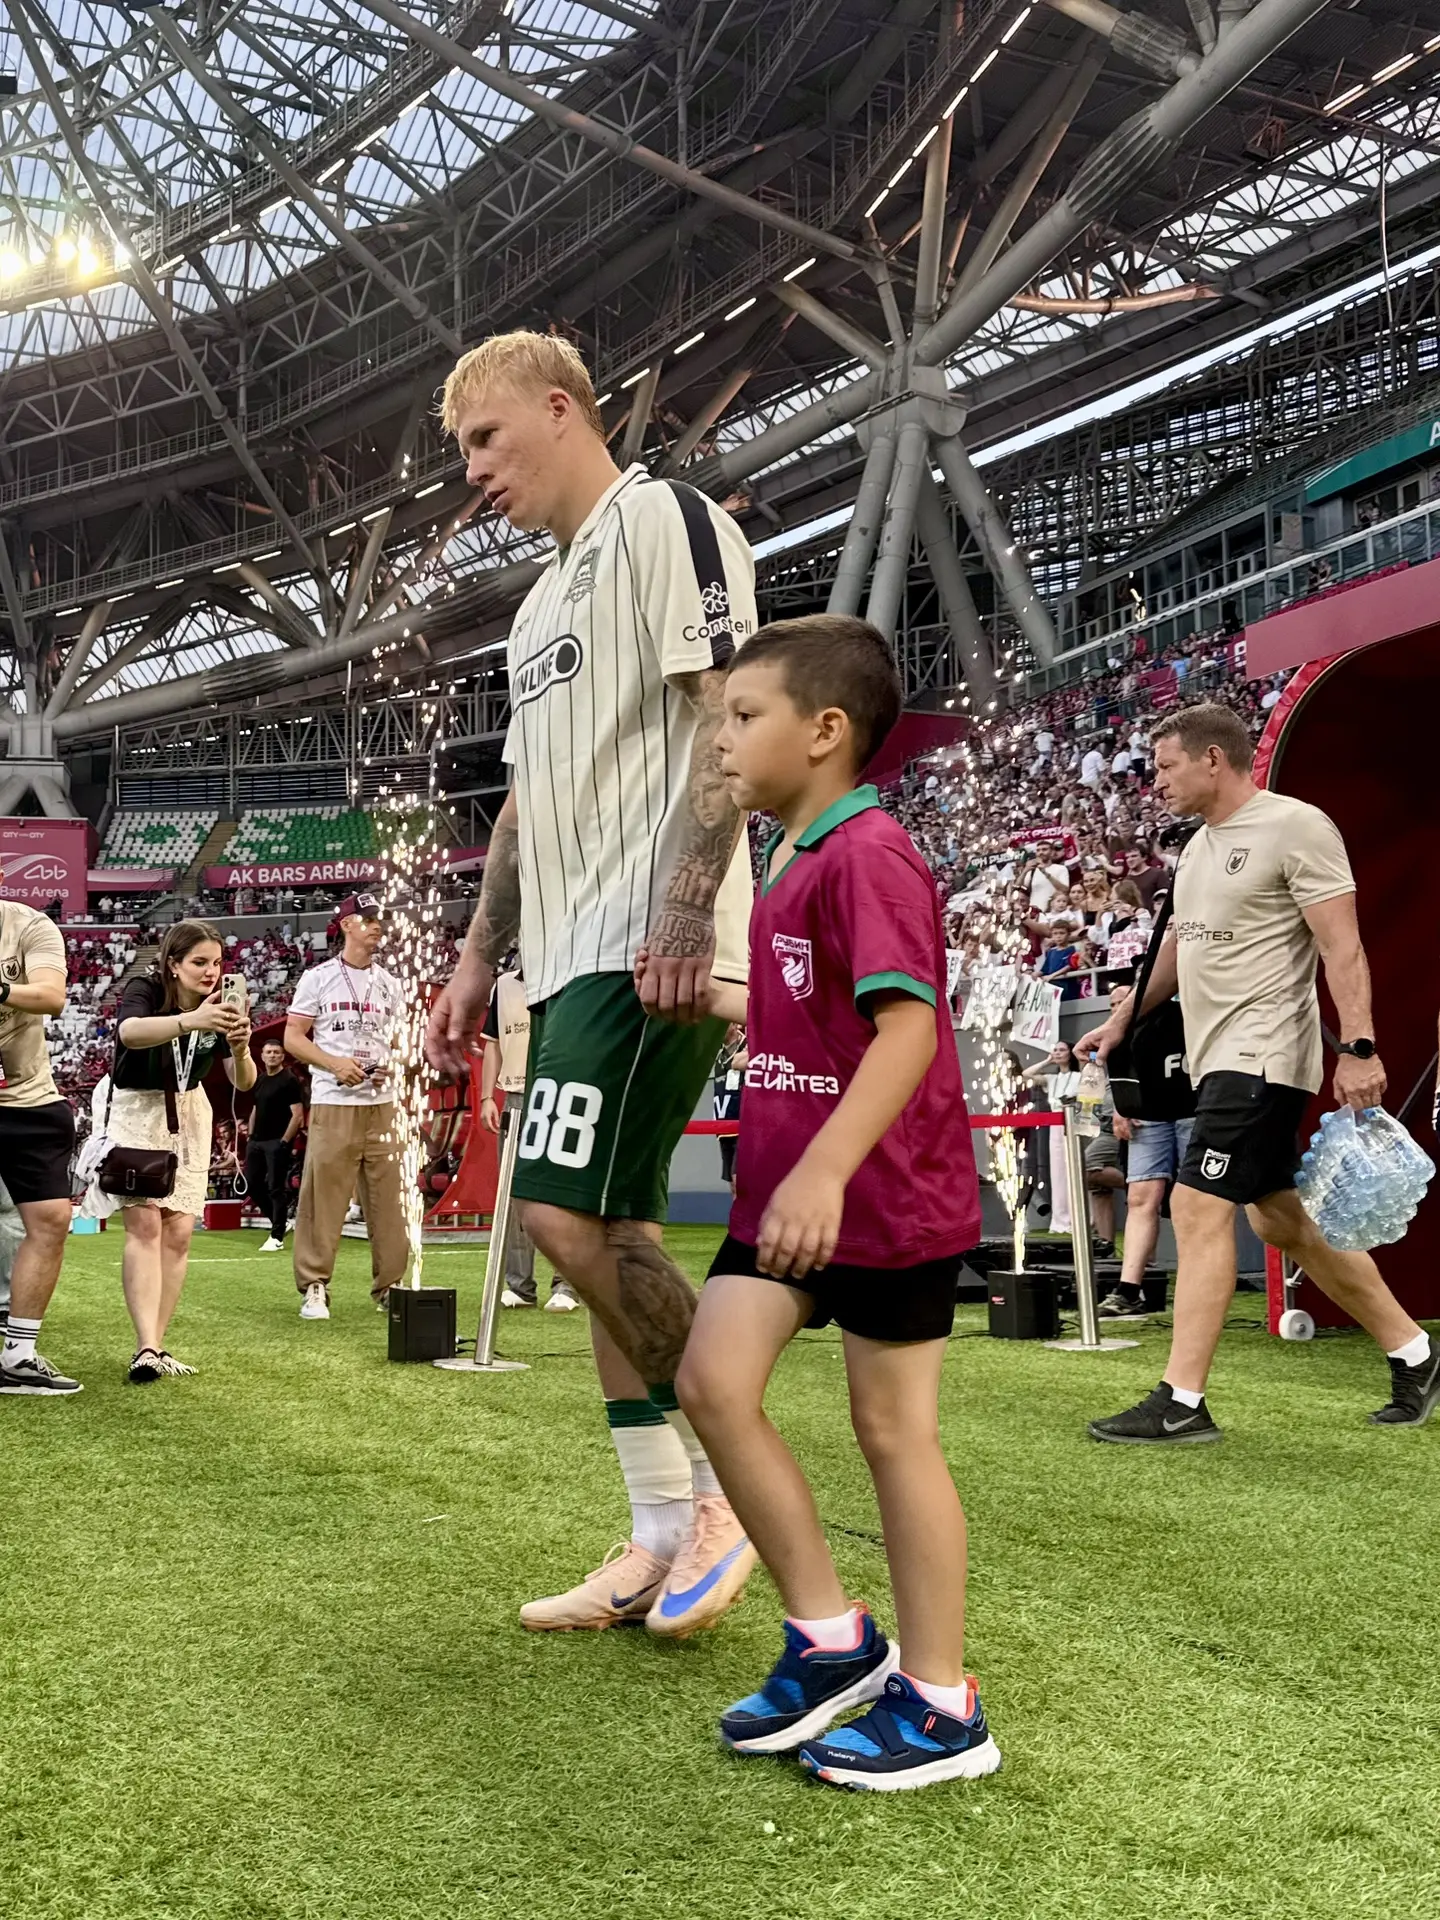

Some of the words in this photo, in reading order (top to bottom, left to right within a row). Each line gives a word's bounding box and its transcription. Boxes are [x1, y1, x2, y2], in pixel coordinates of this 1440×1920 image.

[682, 616, 752, 642] Constell
[228, 868, 254, 885] AK
[258, 866, 306, 884] BARS
[309, 862, 370, 881] ARENA
[0, 885, 28, 897] Bars
[31, 886, 69, 898] Arena
[775, 936, 810, 951] РУБИН
[747, 1052, 795, 1074] АНЬ
[744, 1069, 839, 1094] СИНТЕЗ
[519, 1077, 603, 1169] 88
